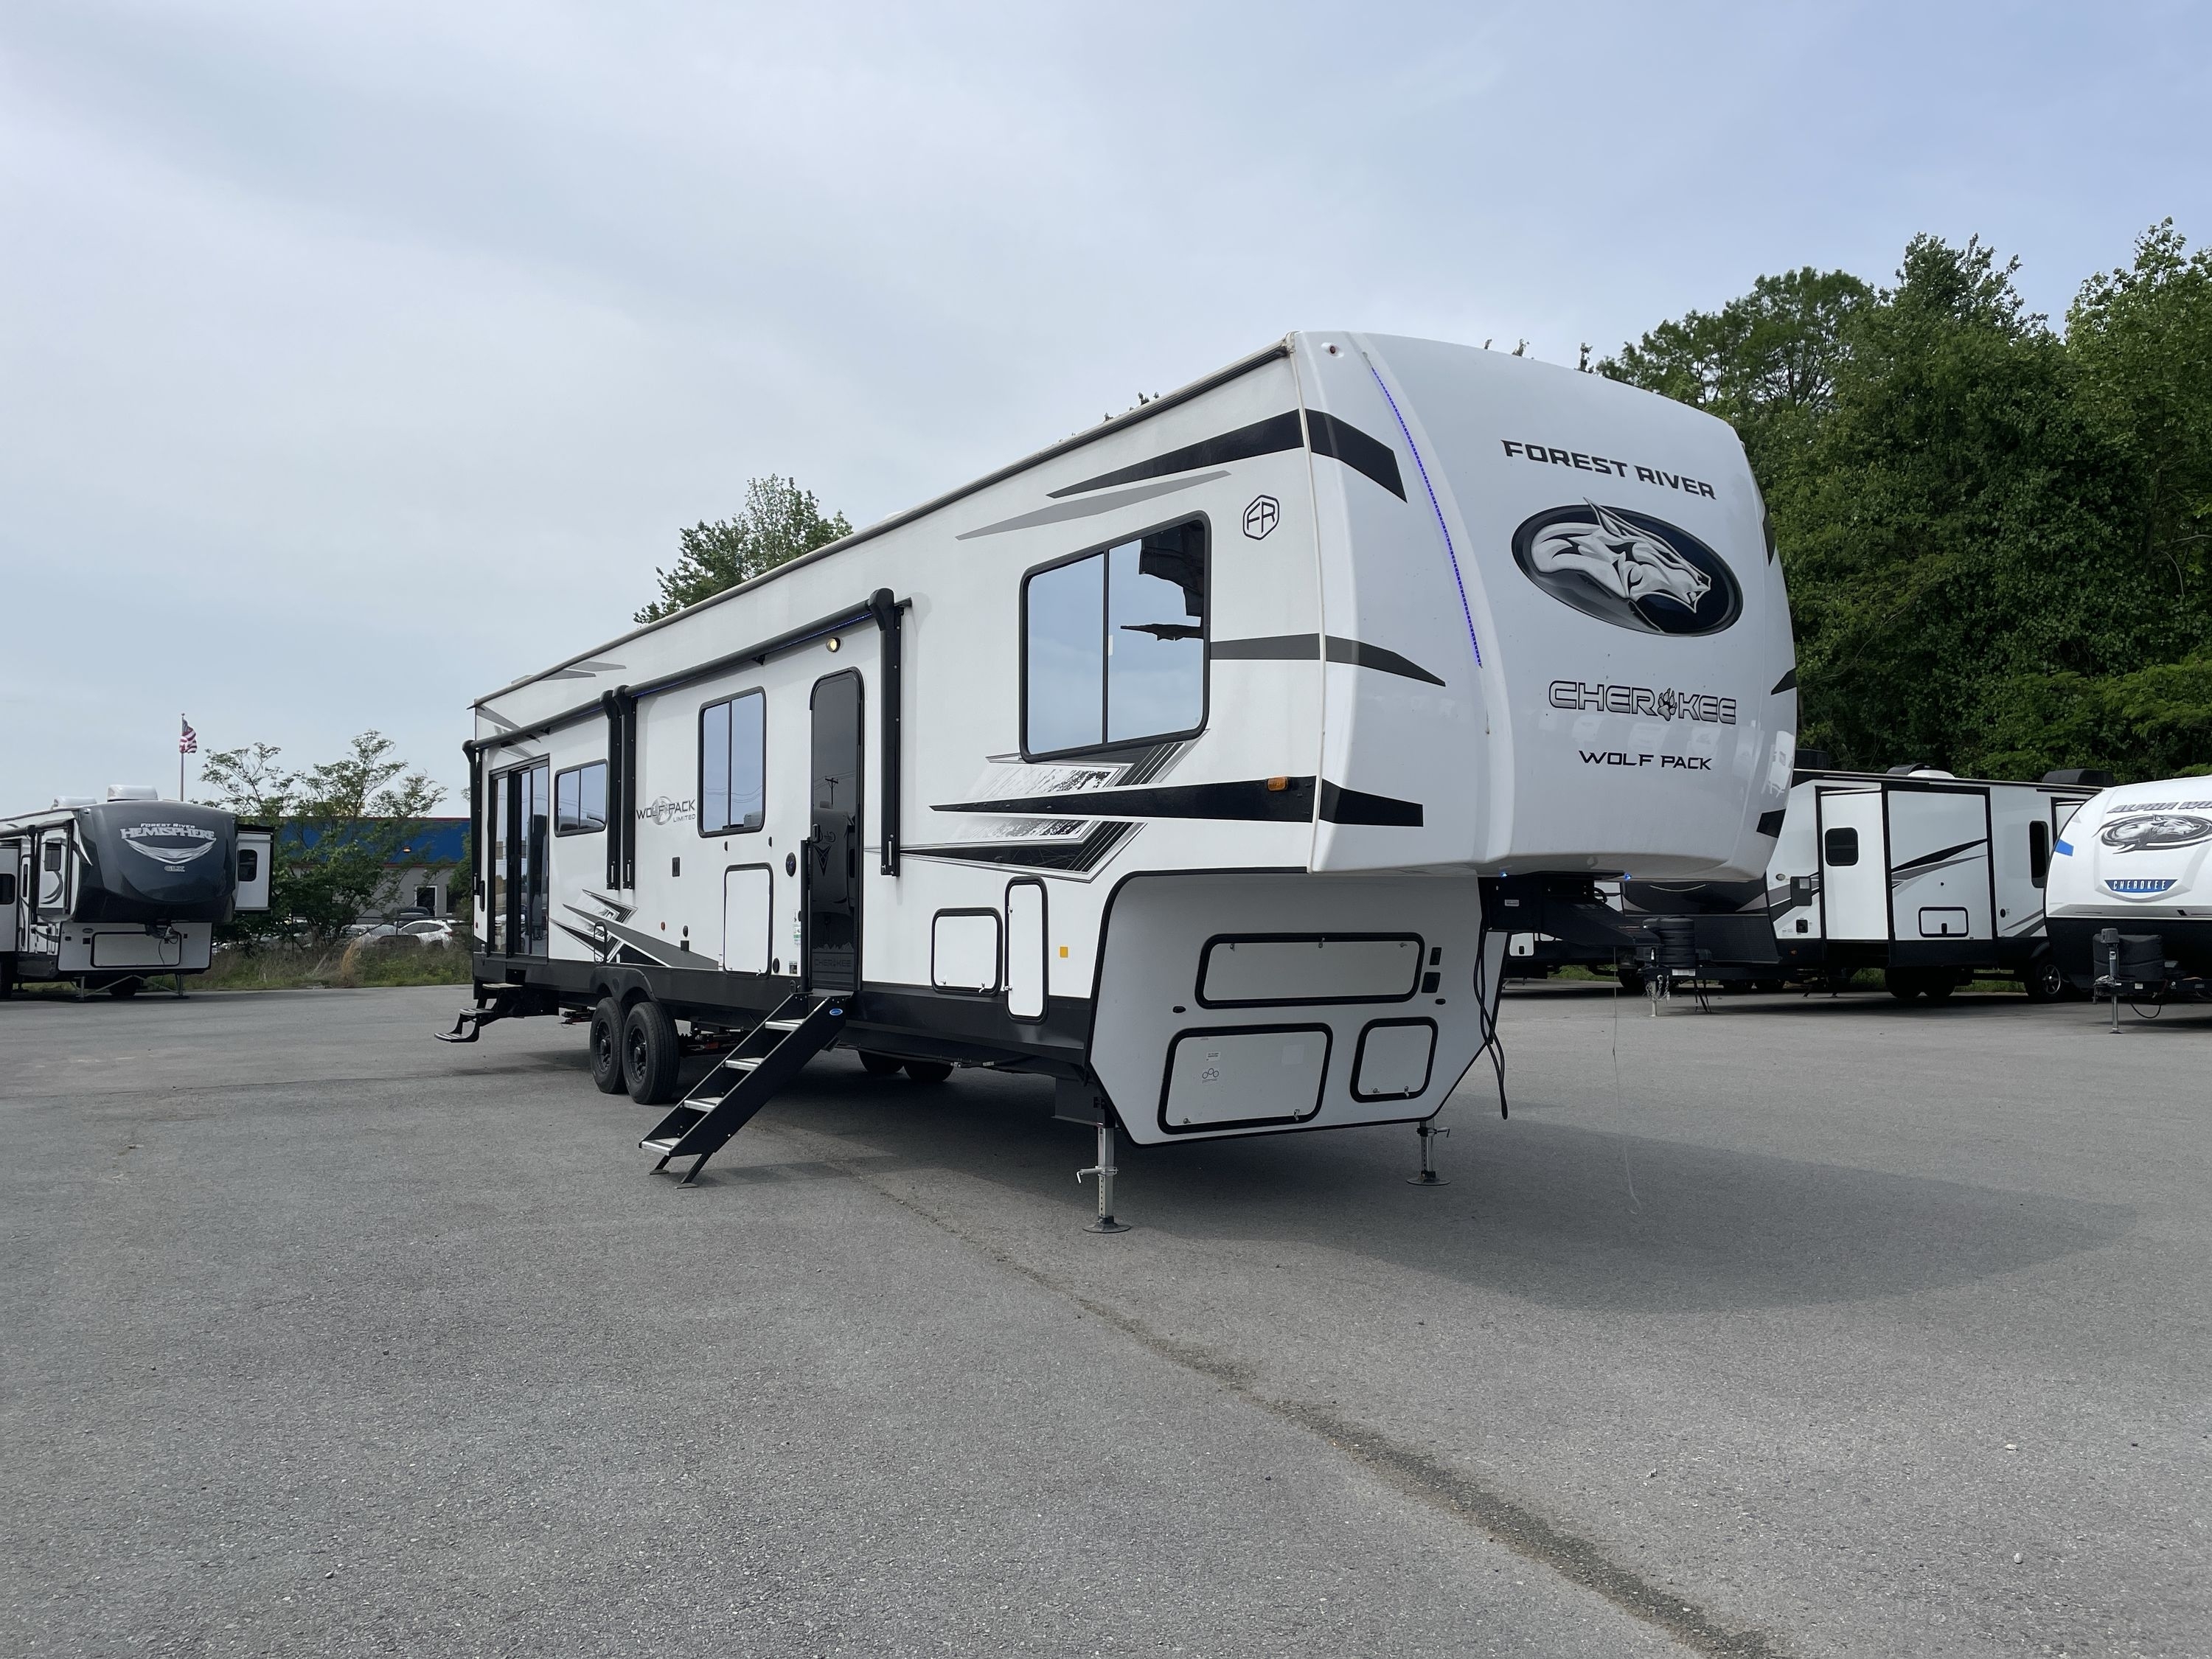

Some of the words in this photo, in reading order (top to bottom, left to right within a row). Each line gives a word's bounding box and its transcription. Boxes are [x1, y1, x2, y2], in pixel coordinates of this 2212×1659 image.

[1500, 439, 1627, 478] FOREST
[1633, 465, 1717, 501] RIVER
[1548, 680, 1737, 725] CHEROKEE
[1578, 750, 1654, 768] WOLF
[1660, 755, 1713, 771] PACK
[636, 804, 666, 821] WOLF
[668, 799, 696, 815] PACK
[2106, 801, 2180, 814] ALPHA
[673, 813, 696, 823] LIMITED
[119, 826, 216, 841] HEMISPHERE
[2112, 880, 2166, 891] CHEROKEE
